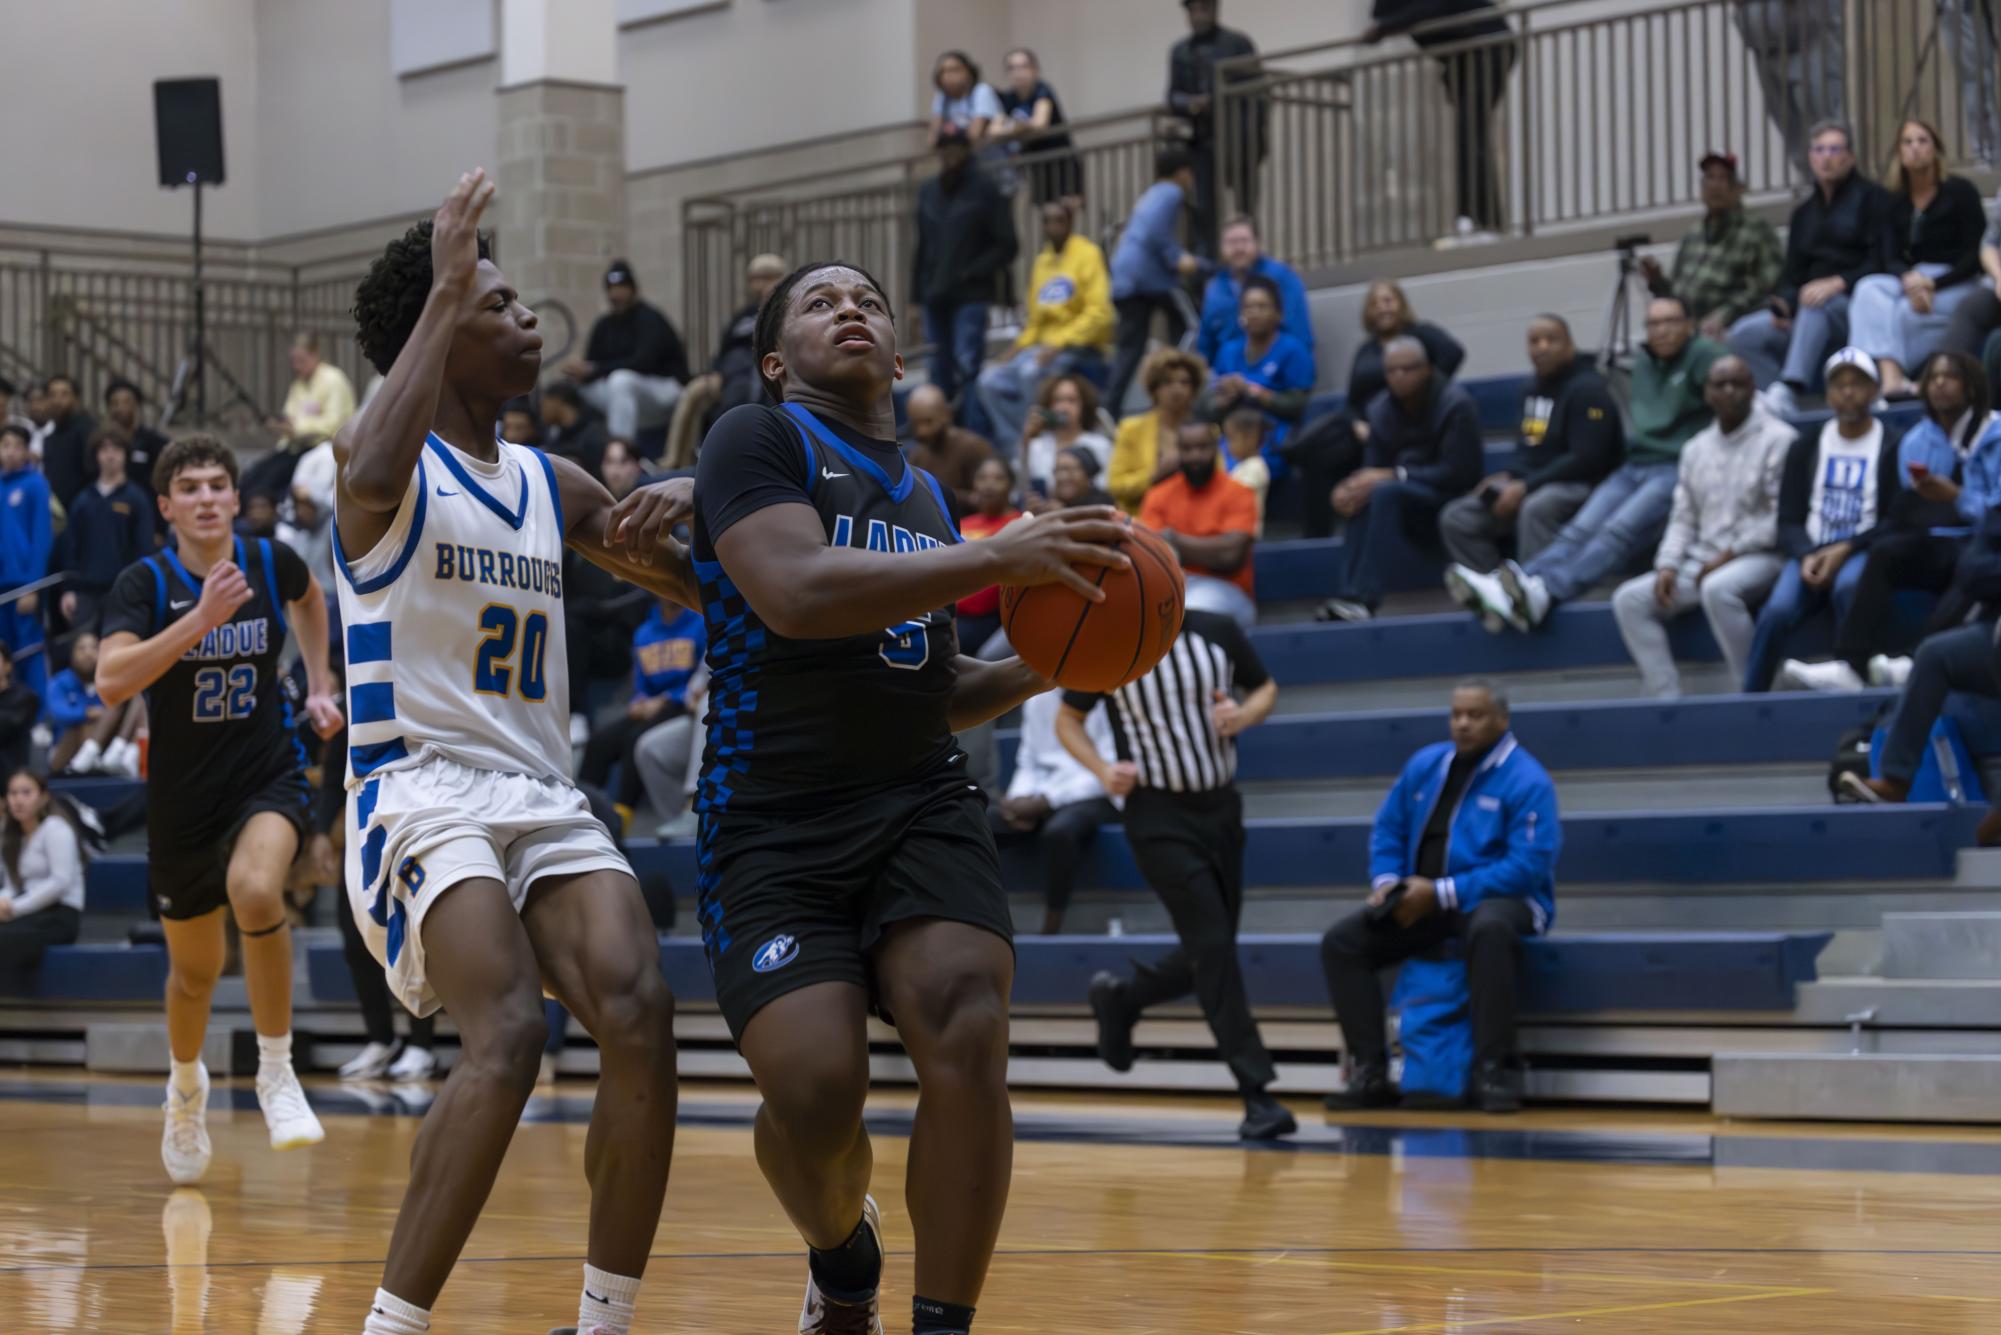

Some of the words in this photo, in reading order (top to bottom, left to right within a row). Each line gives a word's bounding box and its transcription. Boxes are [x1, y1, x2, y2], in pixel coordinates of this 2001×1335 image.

[181, 617, 268, 661] ADUE
[473, 602, 549, 703] 20
[192, 663, 258, 722] 22
